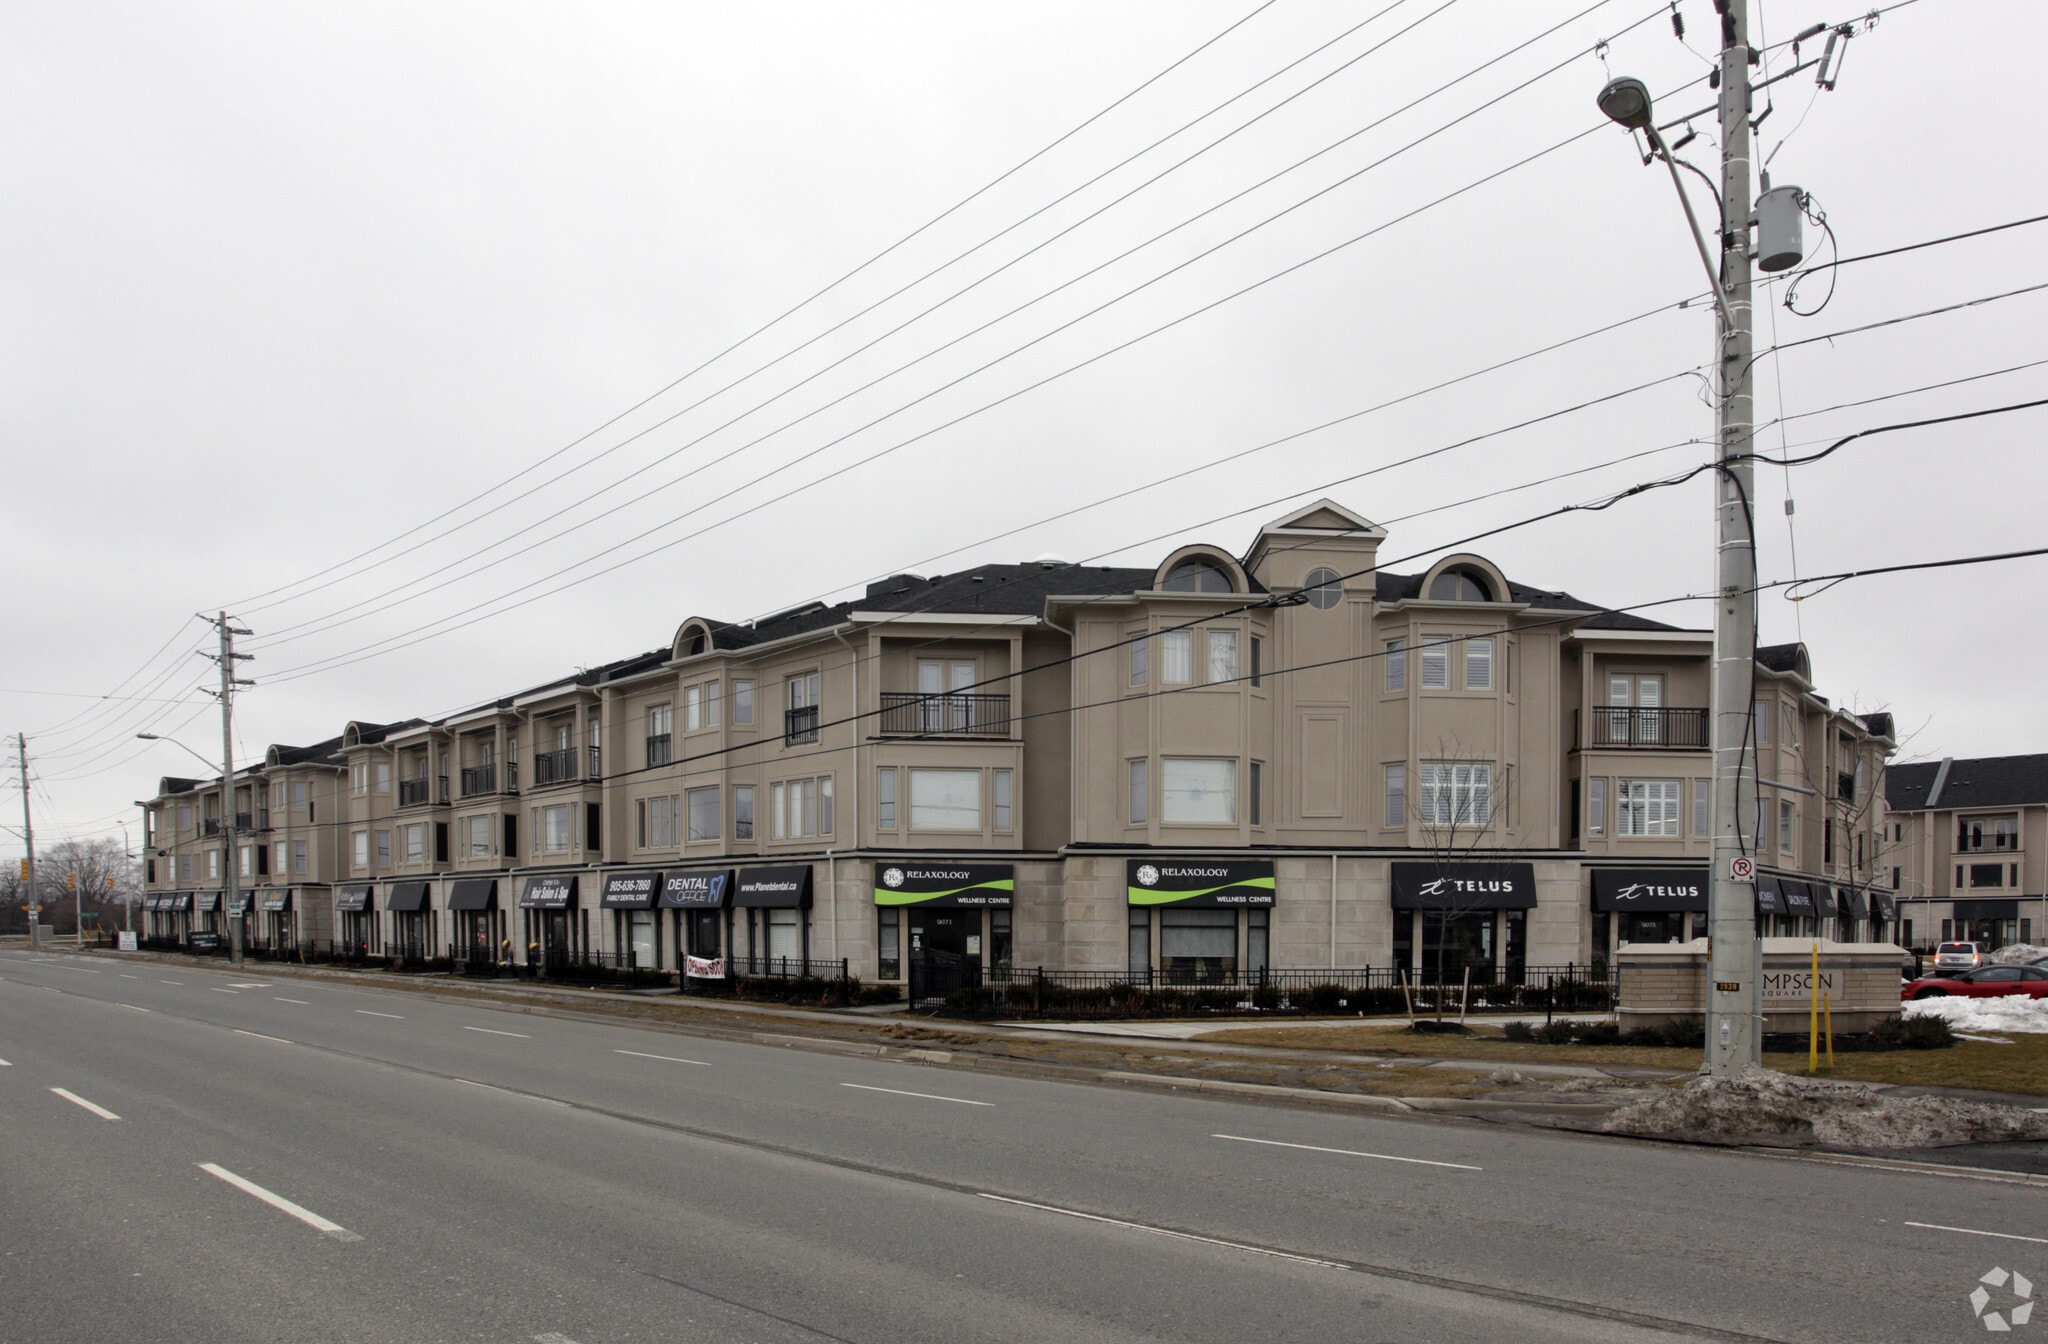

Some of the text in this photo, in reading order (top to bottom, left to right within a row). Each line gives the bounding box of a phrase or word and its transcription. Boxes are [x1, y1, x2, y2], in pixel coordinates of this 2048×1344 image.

[906, 870, 970, 879] RELAXOLOGY
[1161, 868, 1229, 877] RELAXOLOGY
[667, 877, 709, 890] DENTAL
[741, 882, 797, 892] www.Planetdental.ca
[1454, 880, 1513, 892] TELUS
[531, 887, 541, 899] Hair
[541, 886, 554, 899] Salon
[559, 886, 569, 902] Spa
[676, 890, 708, 902] OFFICE
[1646, 886, 1699, 897] TELUS
[1761, 990, 1802, 998] SQUARE
